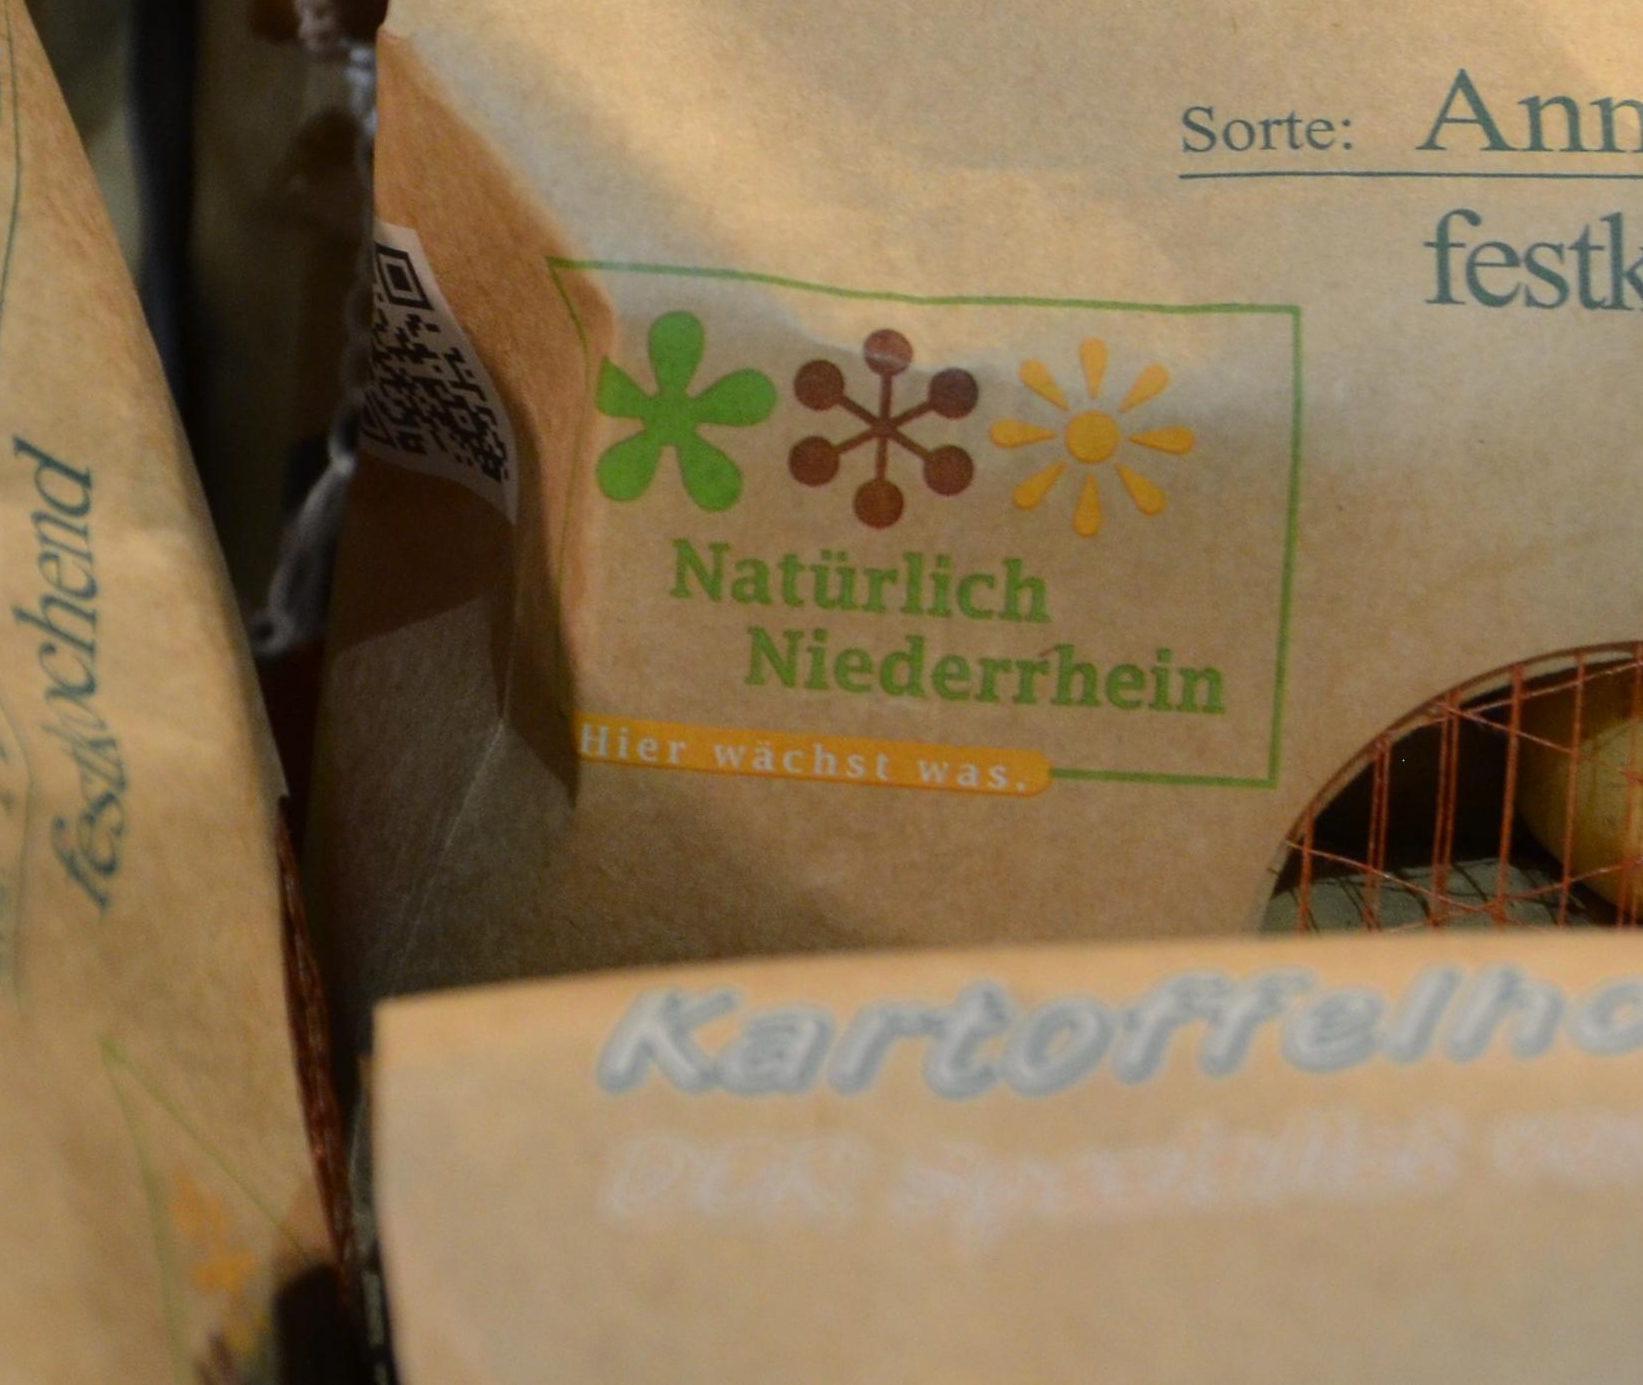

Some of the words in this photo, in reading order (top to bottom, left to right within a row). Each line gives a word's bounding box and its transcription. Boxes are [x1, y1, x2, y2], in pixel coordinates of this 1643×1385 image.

[1181, 104, 1354, 156] Sorte:
[669, 538, 1050, 624] Natürlich
[11, 434, 128, 922] festkochend
[744, 626, 1226, 715] Niederrhein
[577, 723, 688, 768] Hier
[713, 739, 890, 784] wächst
[917, 753, 1030, 793] was.
